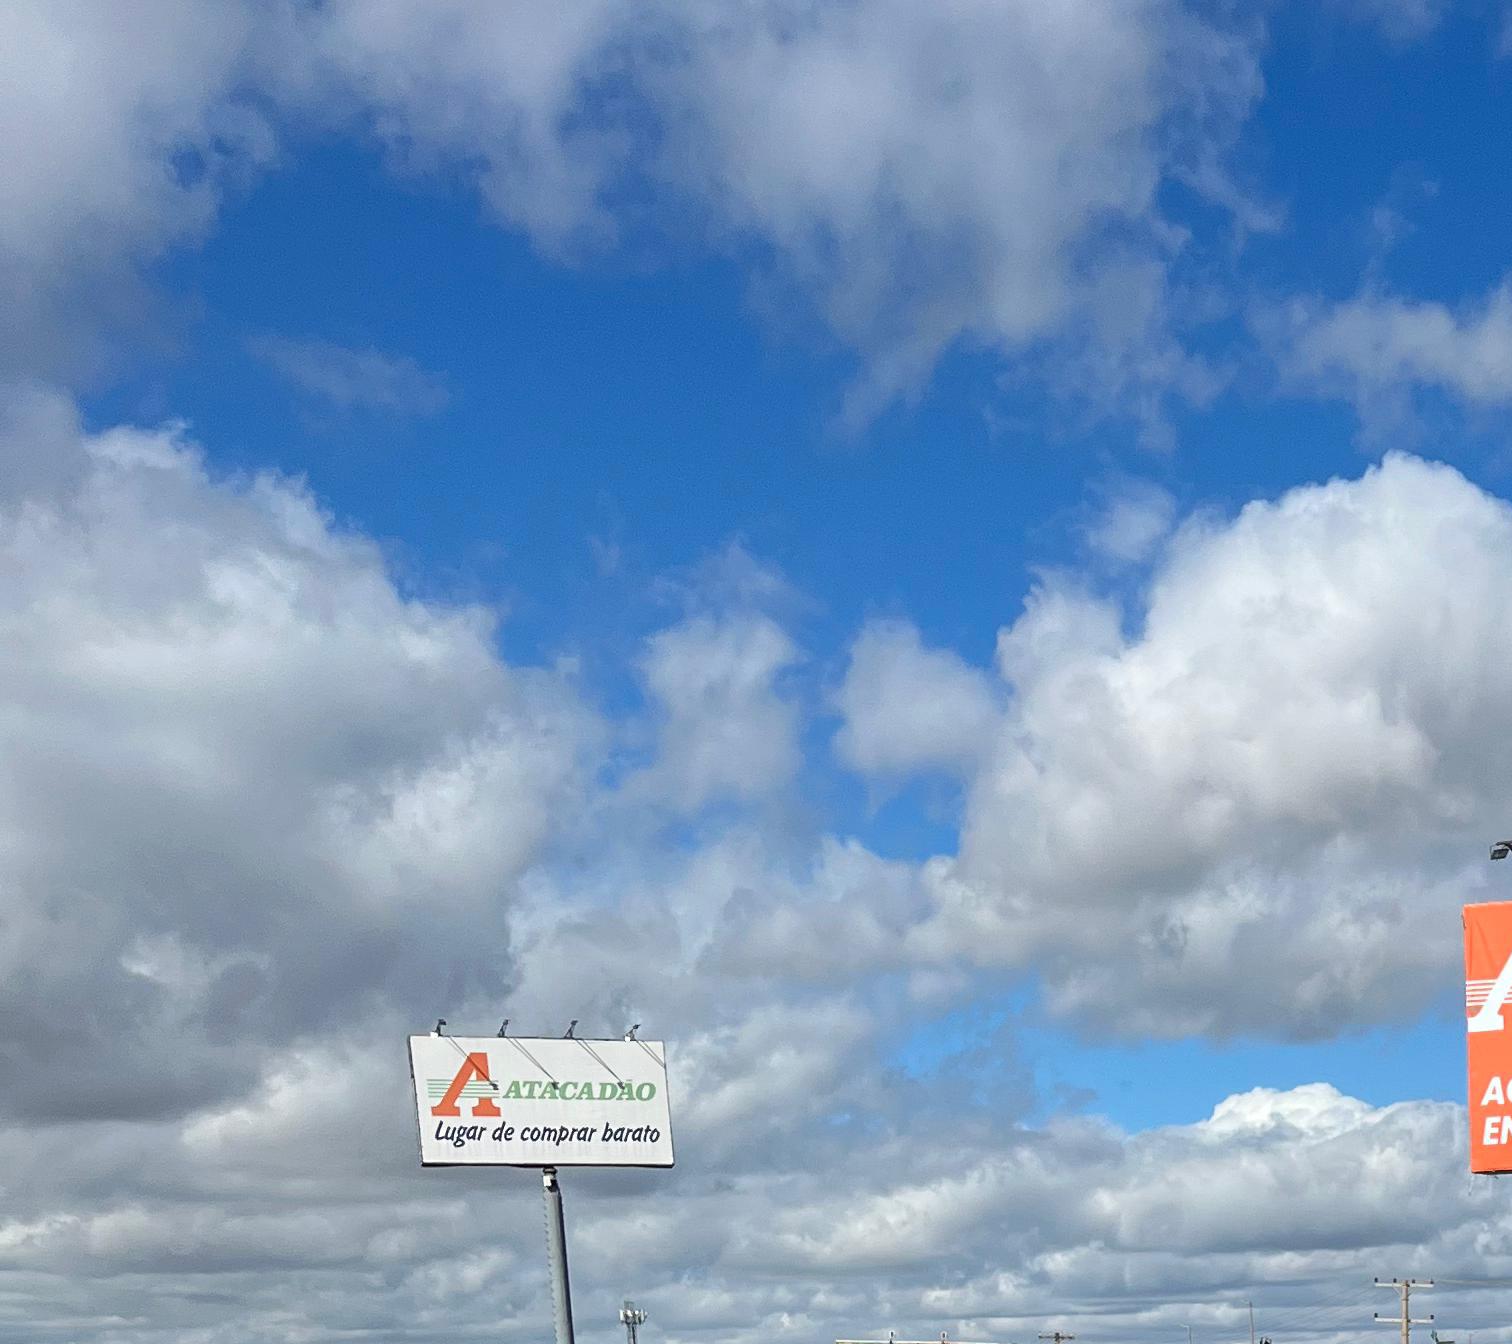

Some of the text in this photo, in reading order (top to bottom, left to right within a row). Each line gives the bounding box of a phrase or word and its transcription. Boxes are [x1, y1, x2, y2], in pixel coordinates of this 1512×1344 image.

[502, 1079, 657, 1102] ATACADÃO
[434, 1120, 661, 1148] Lugar de comprar barato
